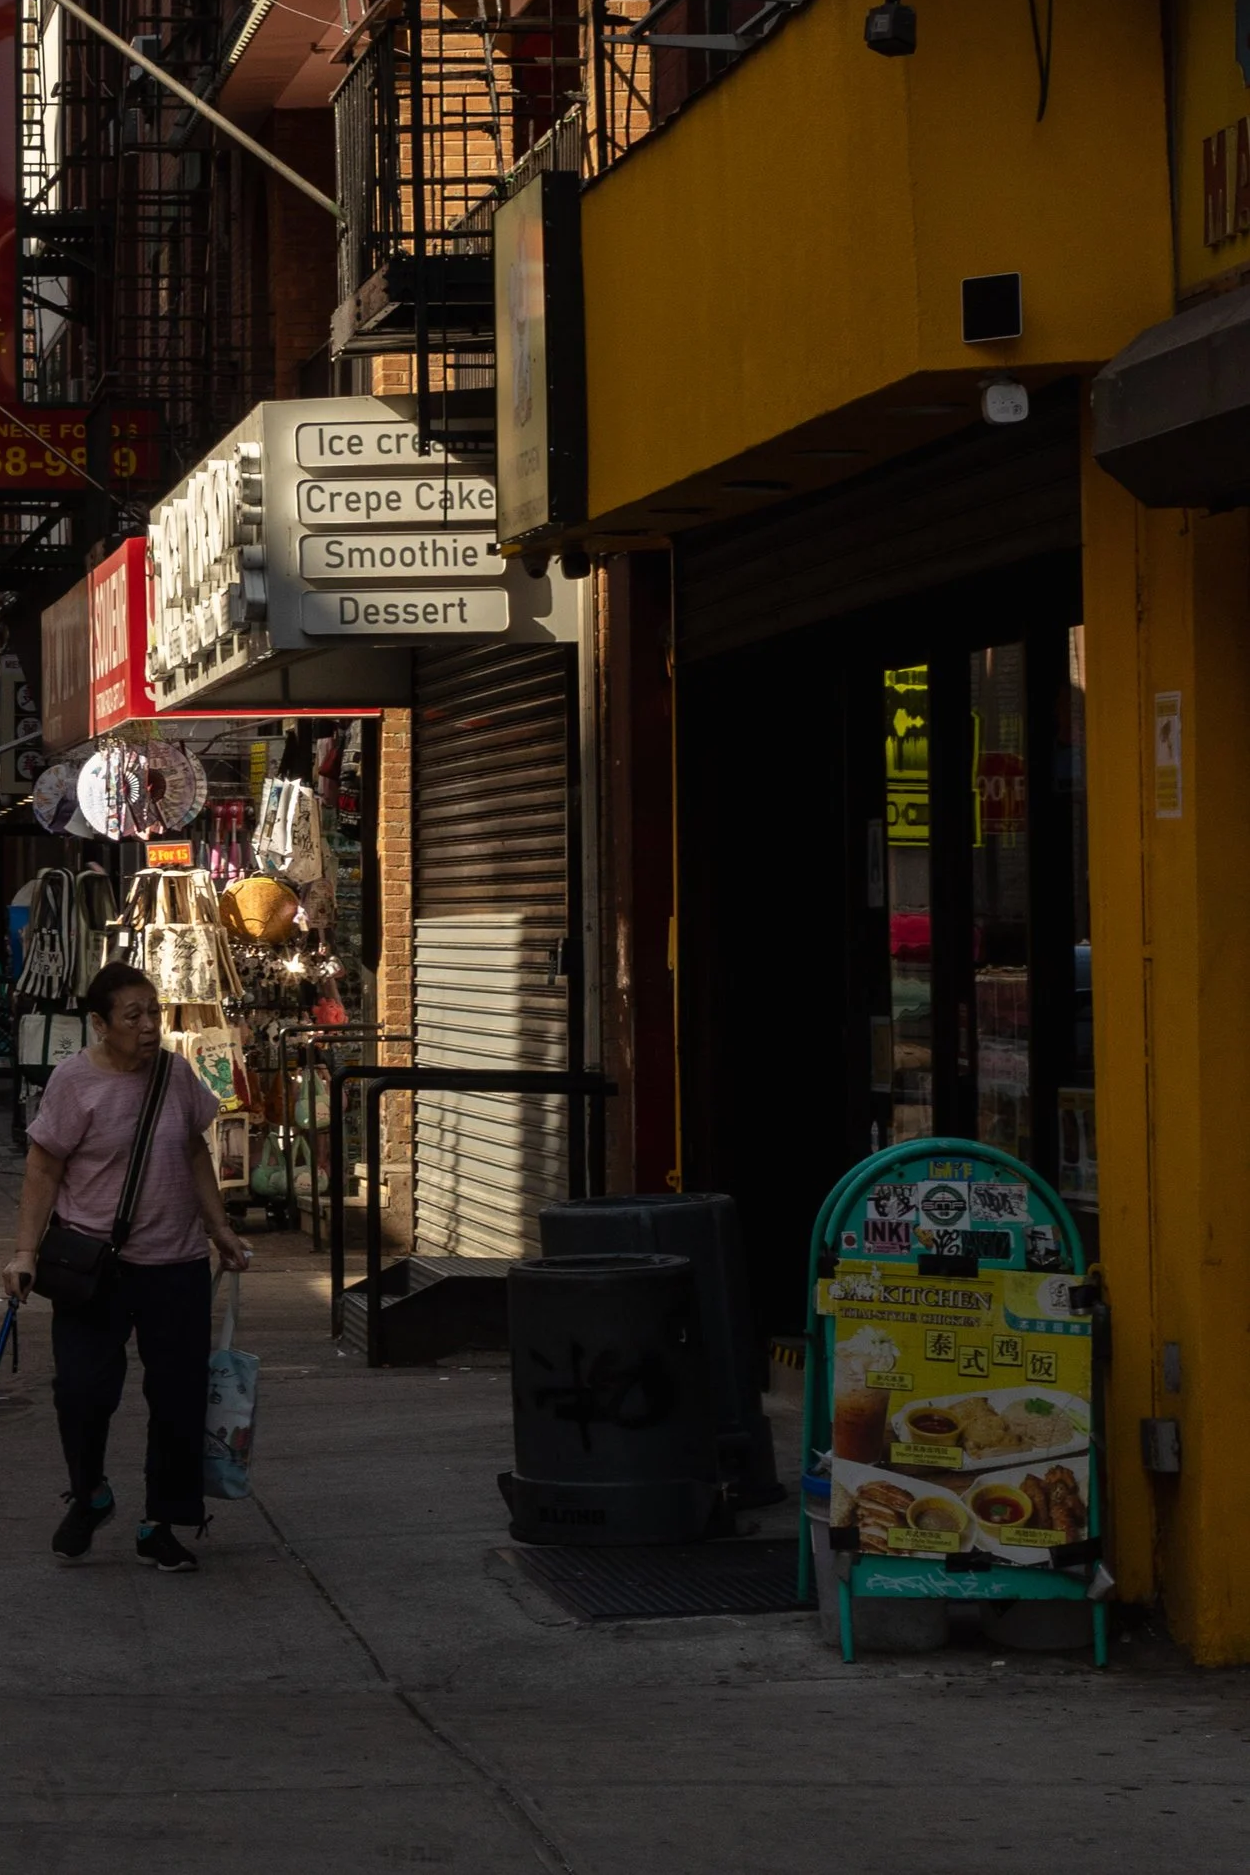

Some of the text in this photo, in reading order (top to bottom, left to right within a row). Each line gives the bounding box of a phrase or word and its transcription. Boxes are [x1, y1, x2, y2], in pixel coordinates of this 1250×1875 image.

[318, 427, 364, 456] Ice
[306, 481, 495, 519] Crepe Cake
[324, 539, 479, 570] Smoothie
[339, 597, 469, 625] Dessert
[149, 850, 157, 861] 2
[177, 849, 188, 860] 15
[879, 1284, 993, 1312] KITCHEN
[922, 1312, 981, 1327] CHICKEN
[929, 1332, 1054, 1377] 泰式鸡饭
